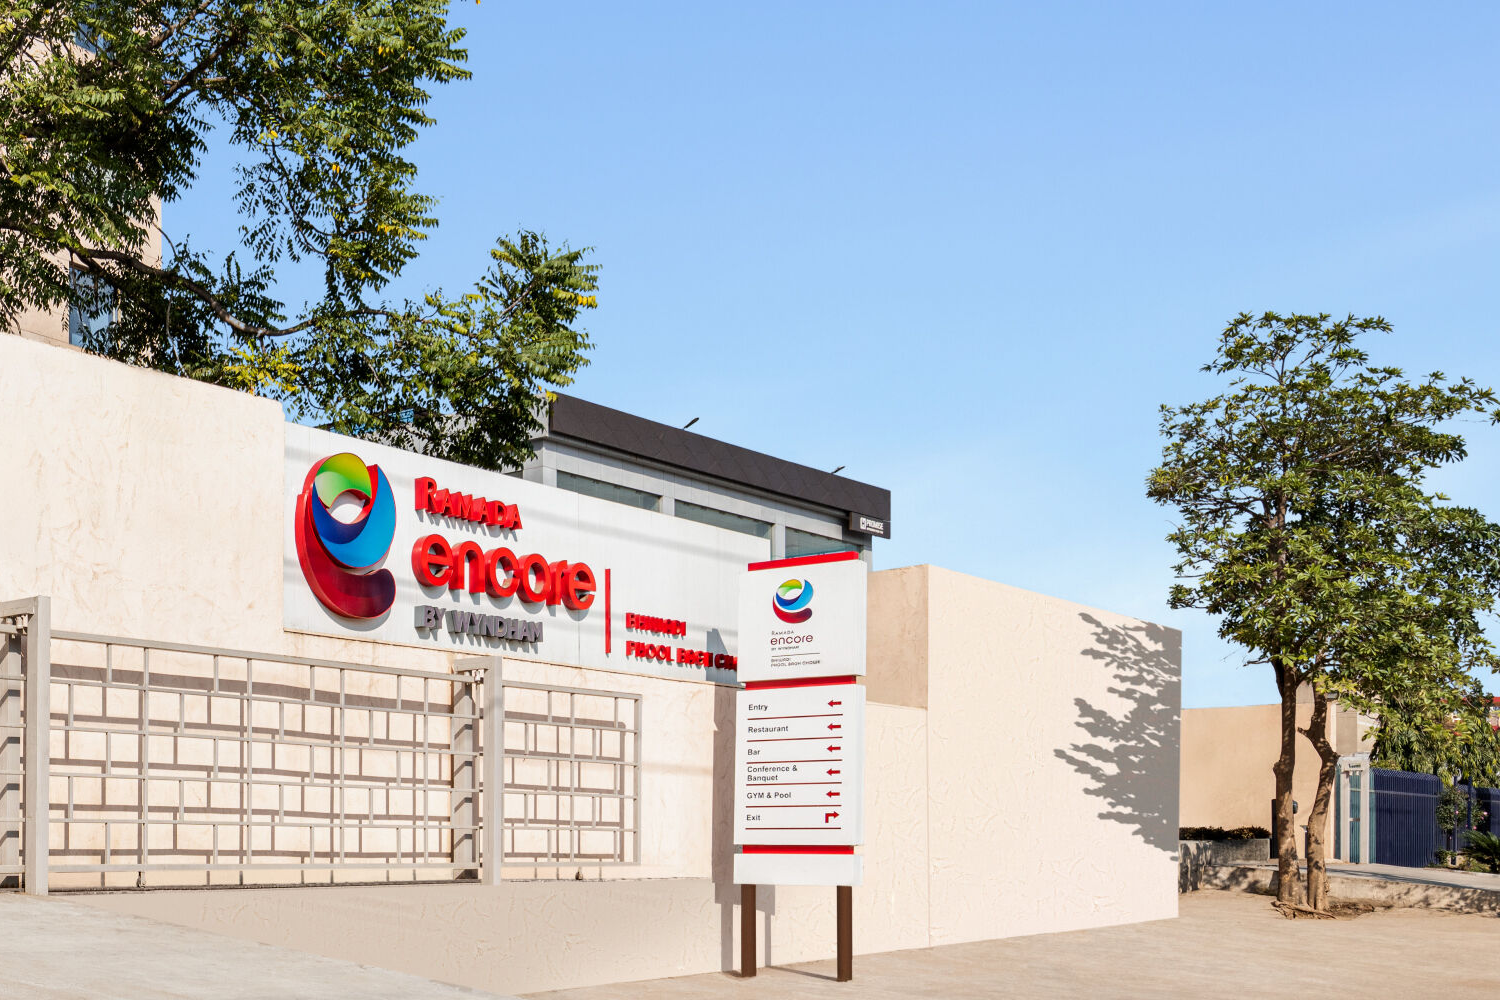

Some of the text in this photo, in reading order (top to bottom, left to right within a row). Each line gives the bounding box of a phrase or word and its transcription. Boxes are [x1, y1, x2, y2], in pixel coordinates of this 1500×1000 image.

[414, 476, 523, 530] RAMADA
[411, 533, 597, 611] encore
[414, 605, 544, 643] BY WYNDHAM
[770, 634, 814, 646] encore
[748, 703, 768, 712] Entry
[747, 725, 789, 733] Restaurant
[747, 765, 790, 773] Conference
[747, 774, 778, 782] Banquet
[774, 791, 792, 799] Pool
